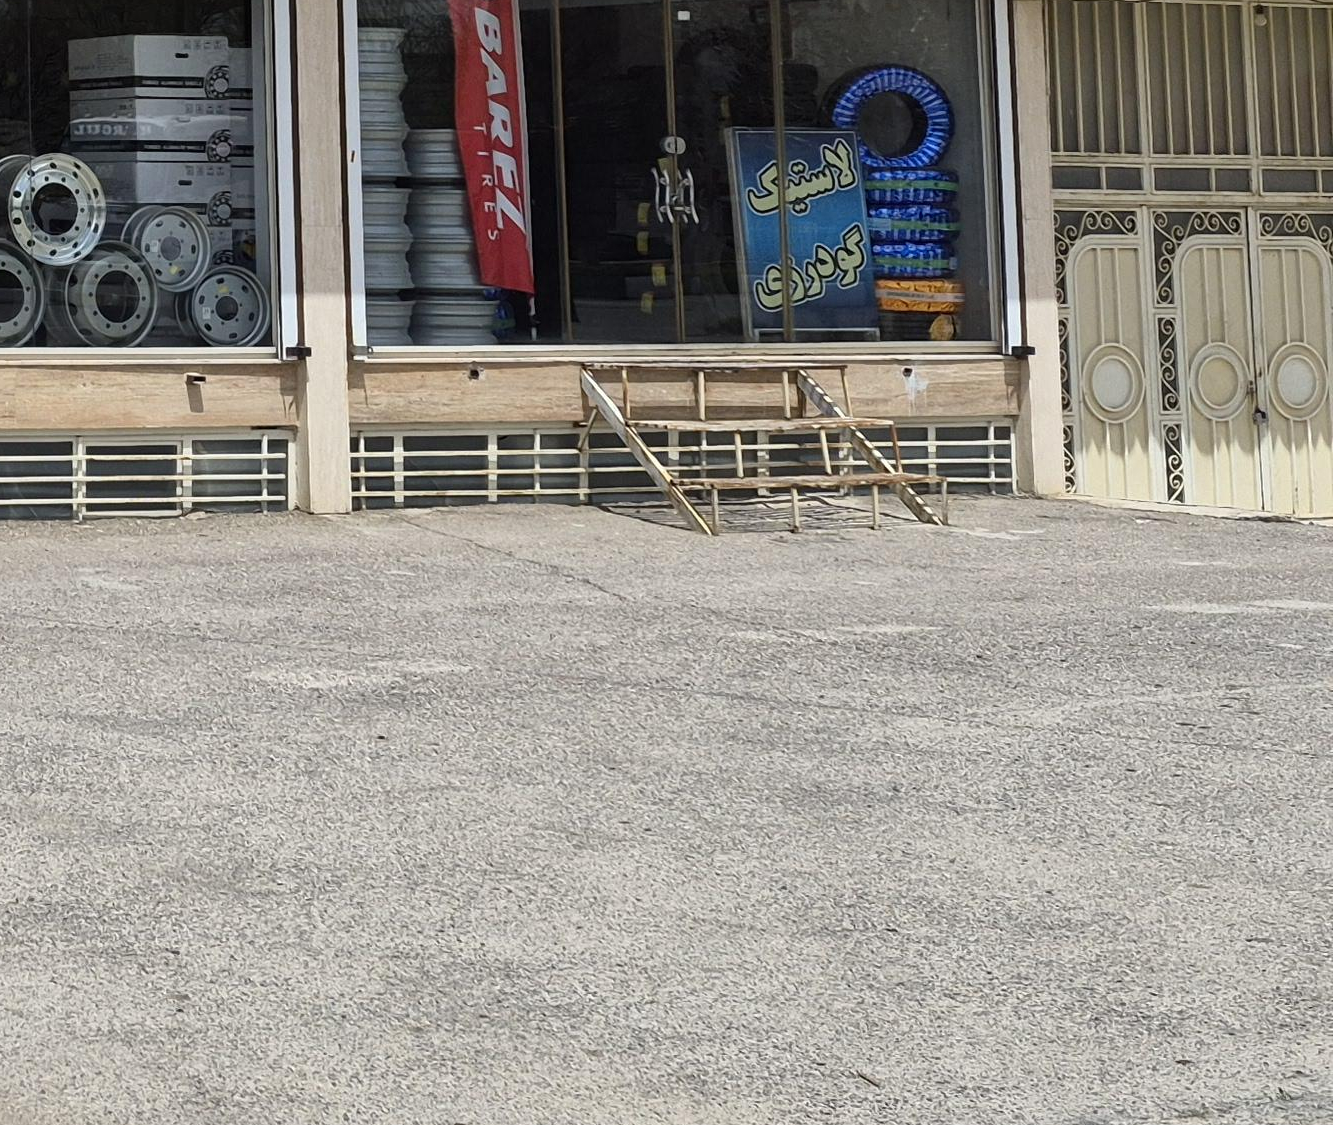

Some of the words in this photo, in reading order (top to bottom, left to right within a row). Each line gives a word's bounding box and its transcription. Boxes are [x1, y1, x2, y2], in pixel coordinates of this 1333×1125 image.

[474, 6, 527, 235] BAREZ
[473, 122, 500, 241] TIRES
[748, 139, 855, 215] لاستیک
[756, 223, 865, 312] گودرزی
